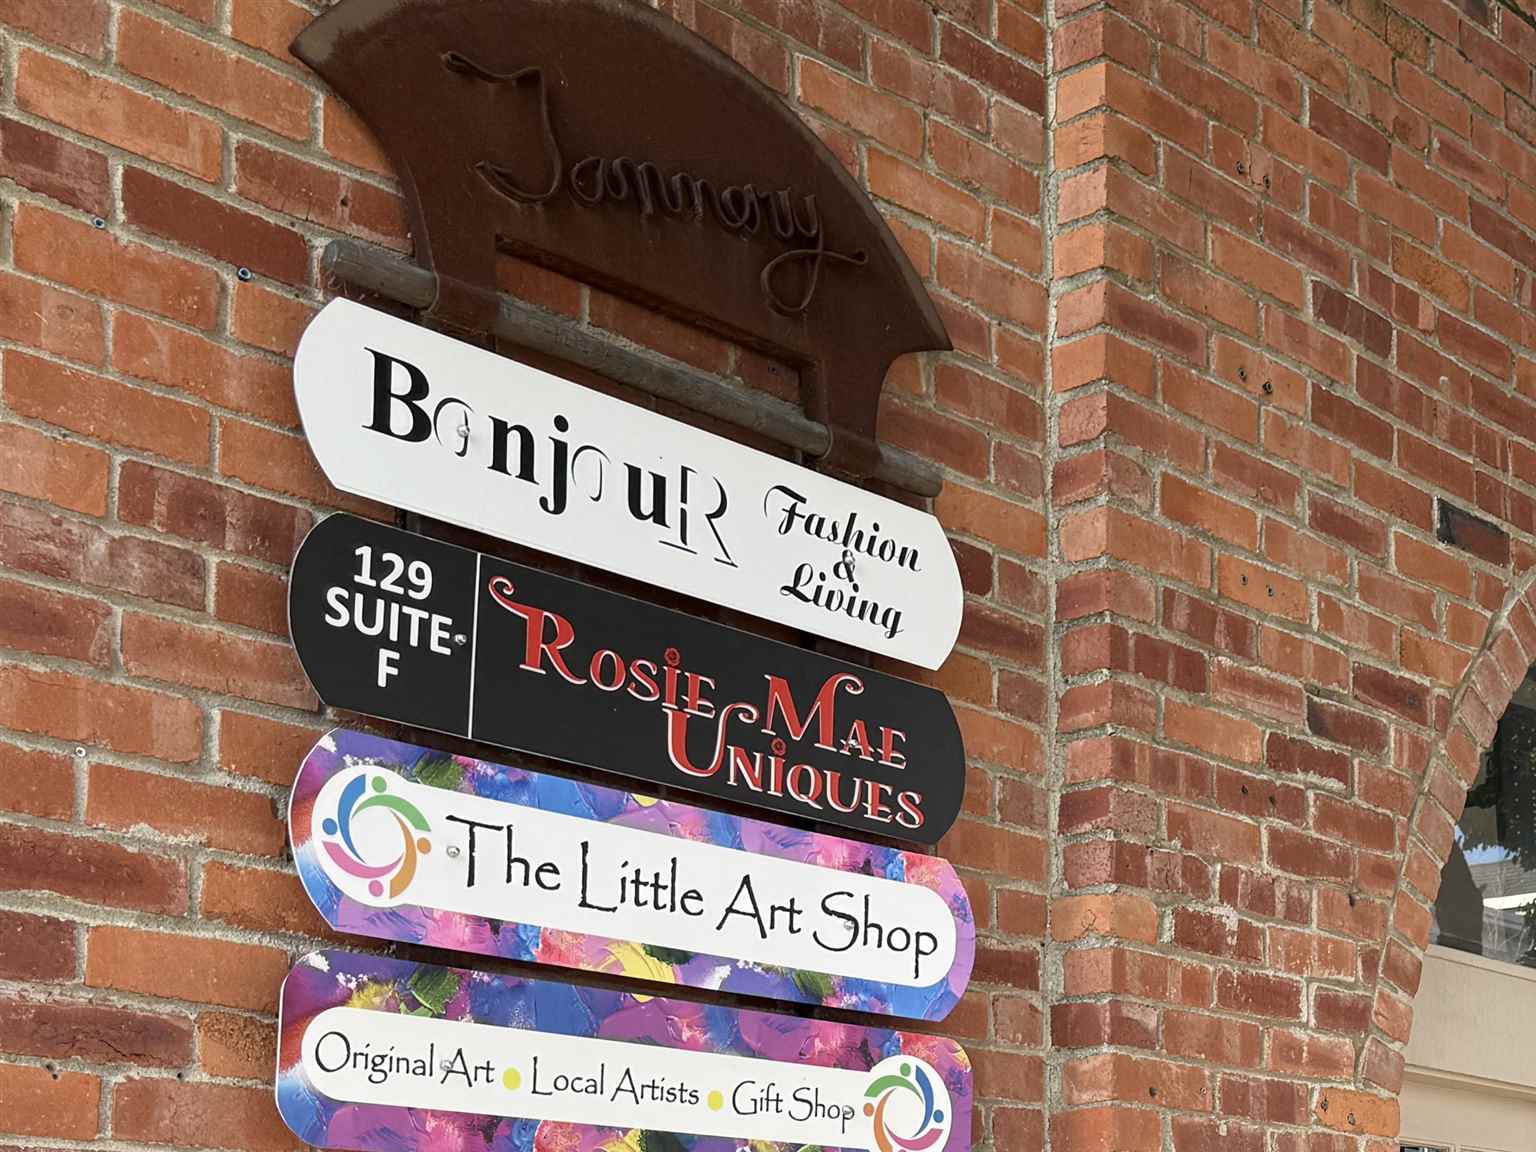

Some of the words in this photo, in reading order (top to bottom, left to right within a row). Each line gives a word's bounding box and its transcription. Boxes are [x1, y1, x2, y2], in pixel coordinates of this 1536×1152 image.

[764, 484, 921, 573] Fashion
[352, 545, 434, 600] 129
[780, 562, 904, 639] Living
[833, 549, 856, 582] &
[325, 588, 453, 656] SUITE
[377, 648, 400, 688] F
[446, 815, 561, 890] The
[579, 841, 705, 918] Little
[717, 874, 803, 939] Art
[813, 891, 938, 980] Shop
[314, 1031, 435, 1084] Original
[440, 1049, 495, 1086] Art
[532, 1057, 605, 1097] Local
[610, 1067, 700, 1106] Artists
[732, 1082, 783, 1117] Gift
[788, 1087, 855, 1133] Shop
